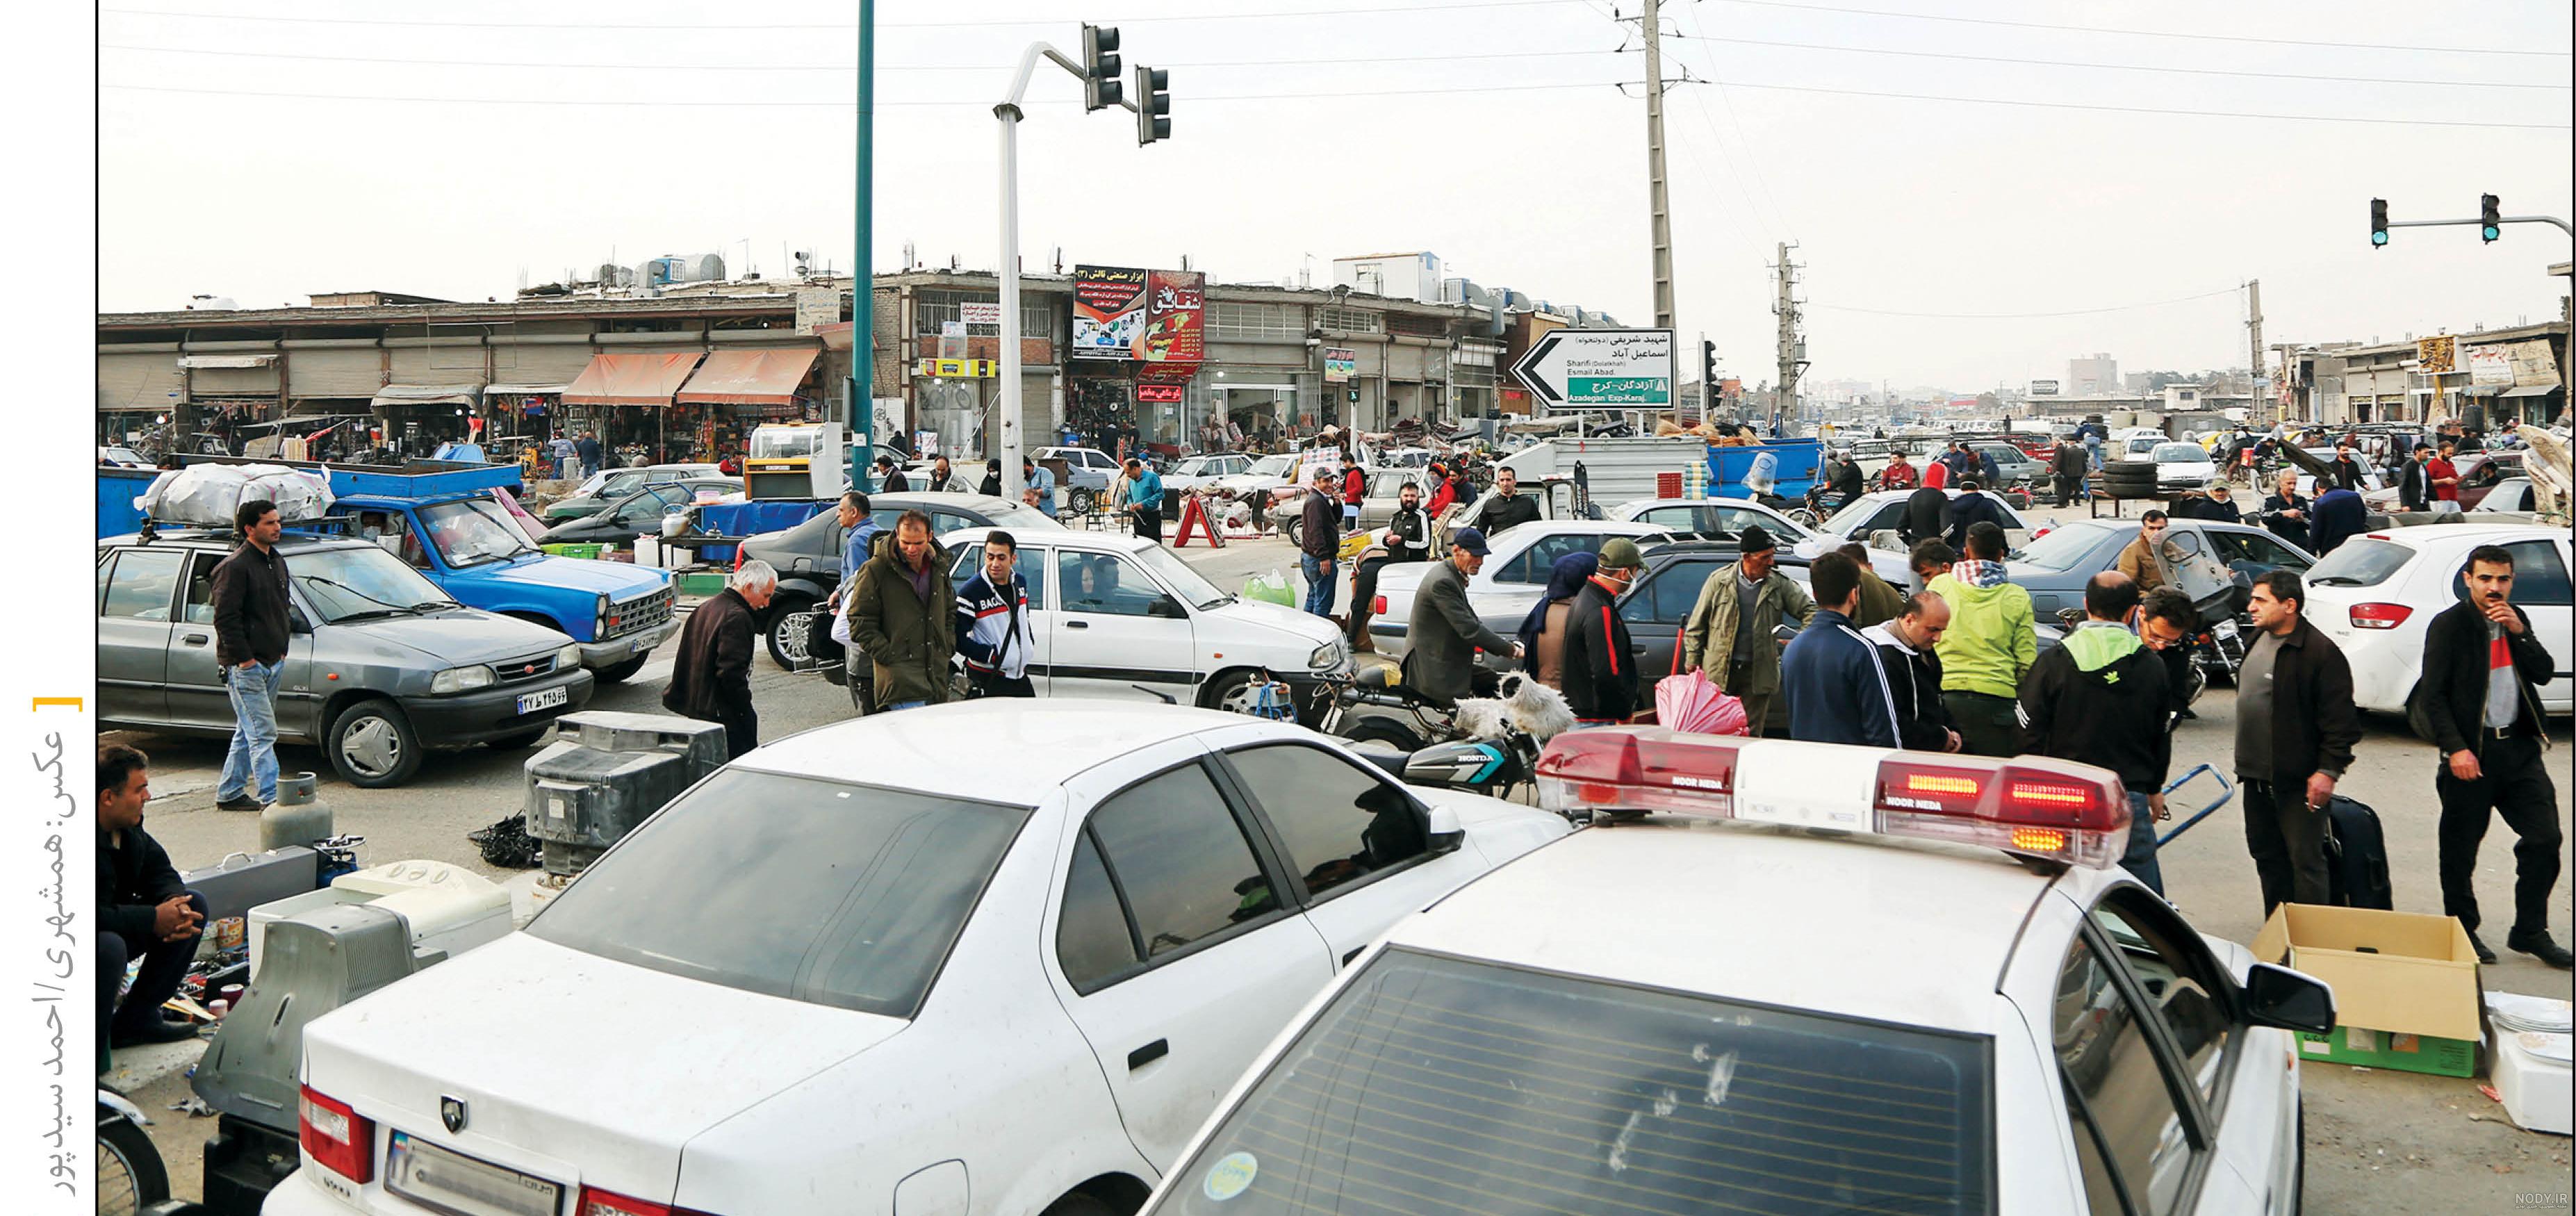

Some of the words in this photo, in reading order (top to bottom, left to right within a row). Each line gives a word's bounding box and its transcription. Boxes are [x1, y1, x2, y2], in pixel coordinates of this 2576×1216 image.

[1107, 272, 1128, 281] صنعتی
[1129, 271, 1145, 282] ابزار
[1151, 295, 1201, 315] شقایق
[1609, 335, 1641, 345] شریفی
[1643, 335, 1668, 345] شهید
[1612, 348, 1630, 359] آباد
[1631, 349, 1668, 360] اسماعیل
[1568, 394, 1605, 402] Azadegan
[1672, 775, 1698, 787] NOOR
[1698, 779, 1723, 789] NEDA
[1886, 796, 1915, 808] NOOR
[1916, 799, 1942, 811] NEDA
